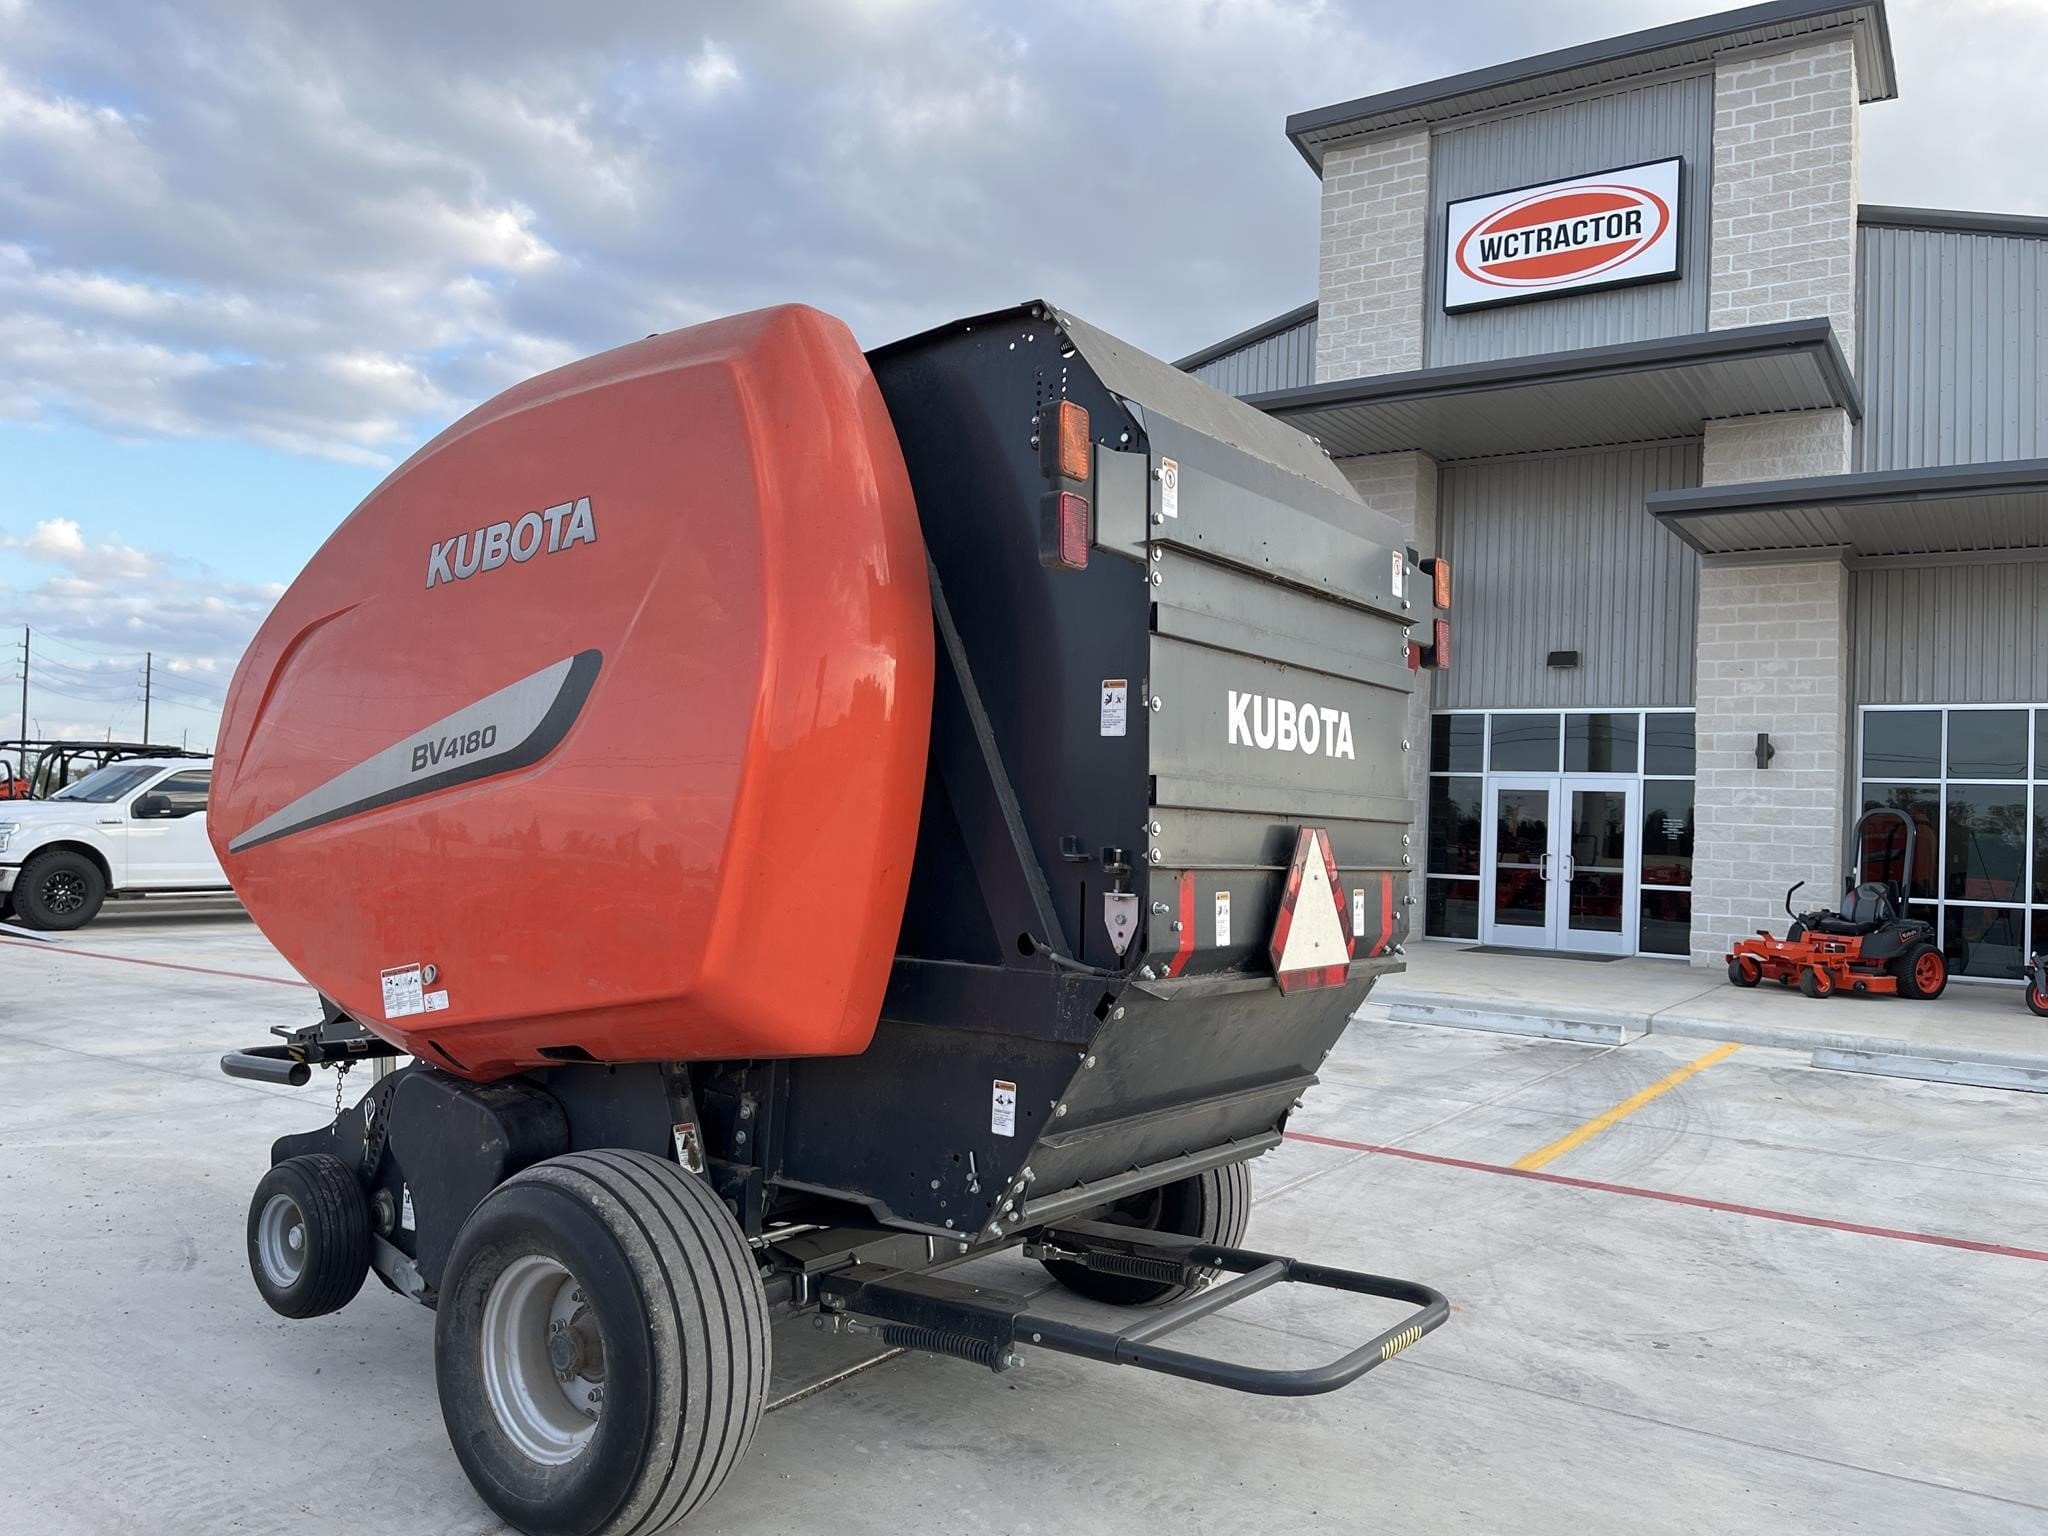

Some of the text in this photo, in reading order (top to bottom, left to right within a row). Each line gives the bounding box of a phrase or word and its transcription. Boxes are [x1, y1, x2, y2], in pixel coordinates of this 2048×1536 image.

[1479, 209, 1642, 263] WCTRACTOR
[425, 496, 597, 590] KUBOTA
[411, 725, 497, 773] BV4180
[1228, 690, 1356, 760] KUBOTA
